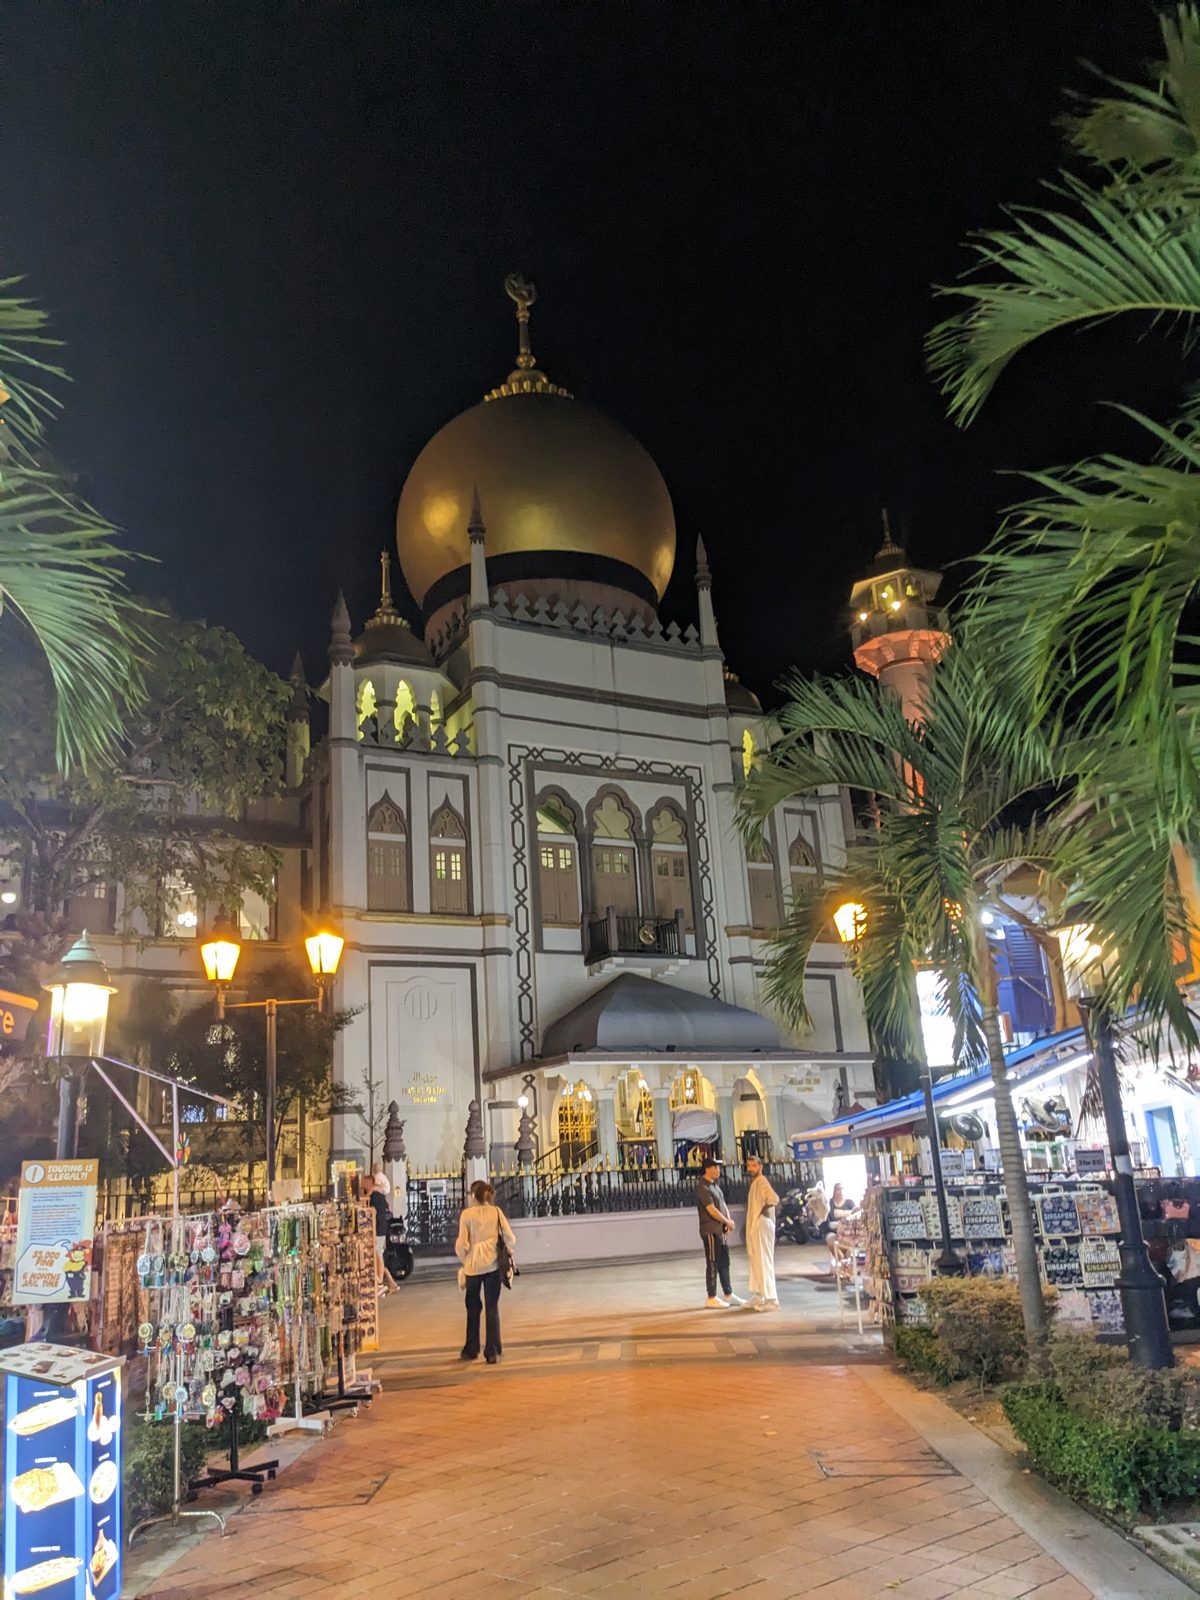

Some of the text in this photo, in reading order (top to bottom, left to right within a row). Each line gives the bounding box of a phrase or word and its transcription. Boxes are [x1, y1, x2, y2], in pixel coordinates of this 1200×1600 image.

[48, 1163, 94, 1173] TOUTING IS
[965, 1215, 999, 1224] SINGAPORE
[1043, 1211, 1076, 1220] SINGAPORE
[35, 1258, 55, 1267] FINE
[1046, 1262, 1080, 1272] SINGAPORE
[1086, 1262, 1119, 1272] SINGAPORE
[30, 1272, 62, 1280] MONTHS
[21, 1280, 59, 1288] JAIL TIME
